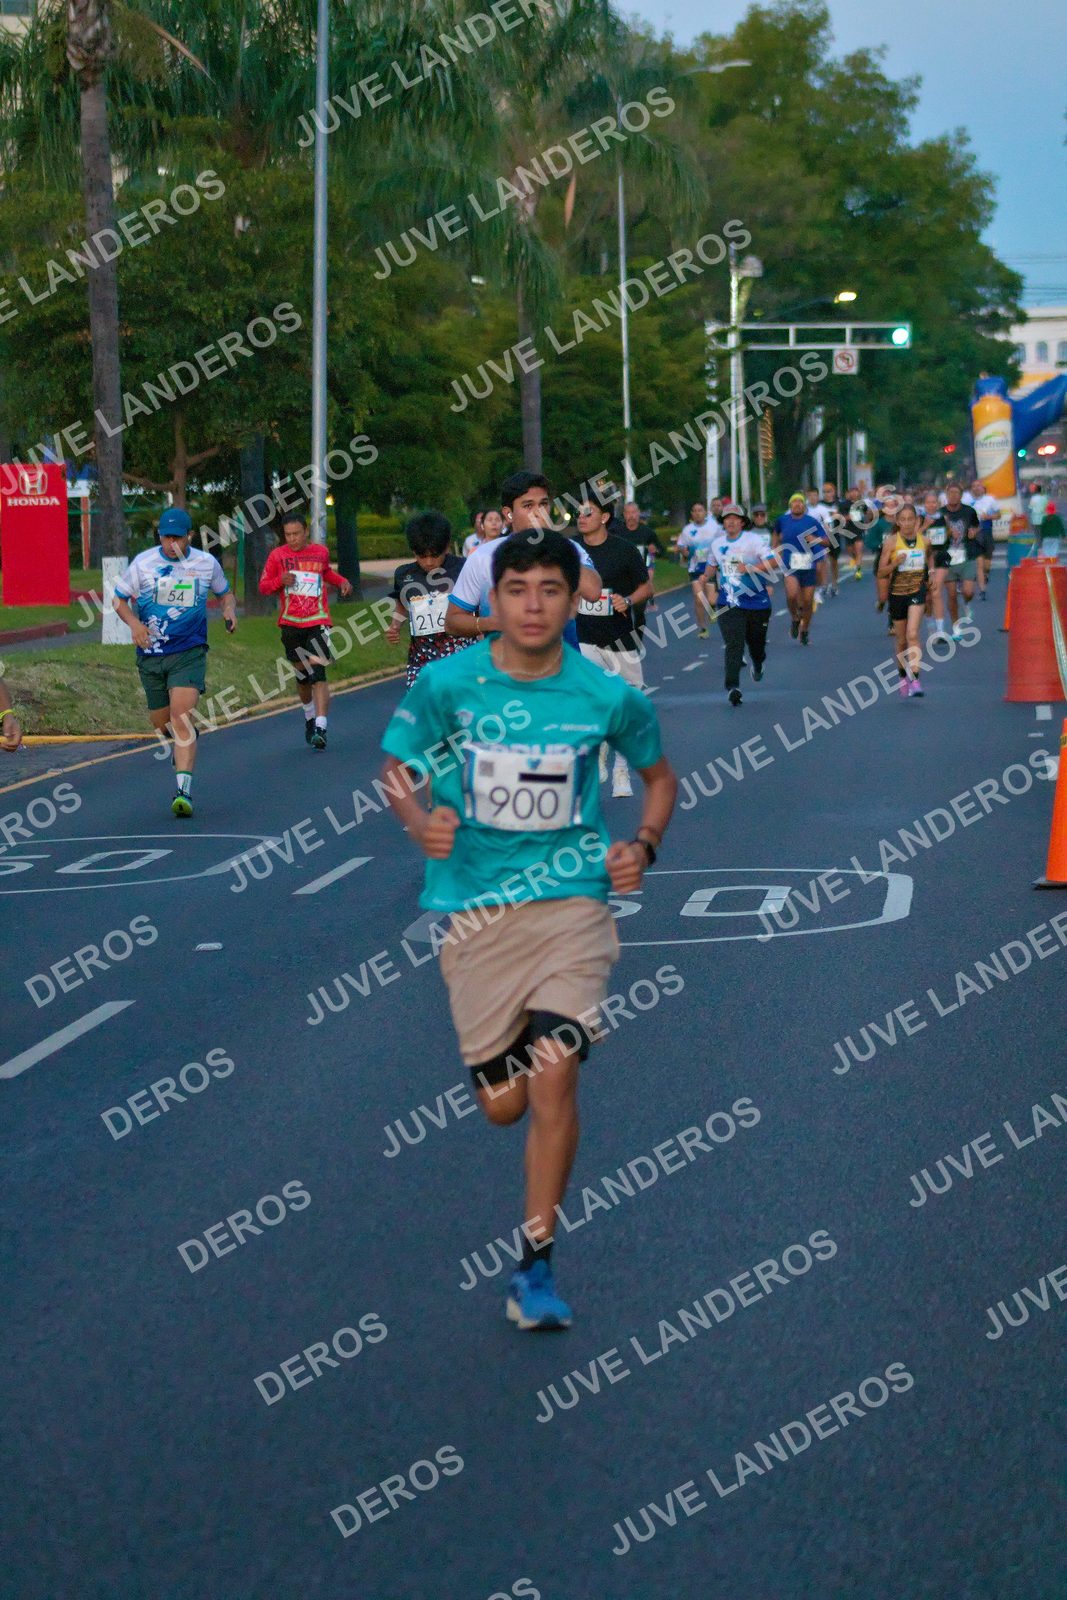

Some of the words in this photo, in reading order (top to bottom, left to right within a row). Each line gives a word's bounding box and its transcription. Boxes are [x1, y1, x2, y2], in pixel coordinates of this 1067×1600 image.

[7, 496, 60, 506] HONDA
[167, 590, 185, 603] 54
[416, 611, 446, 631] 216
[489, 786, 559, 820] 900
